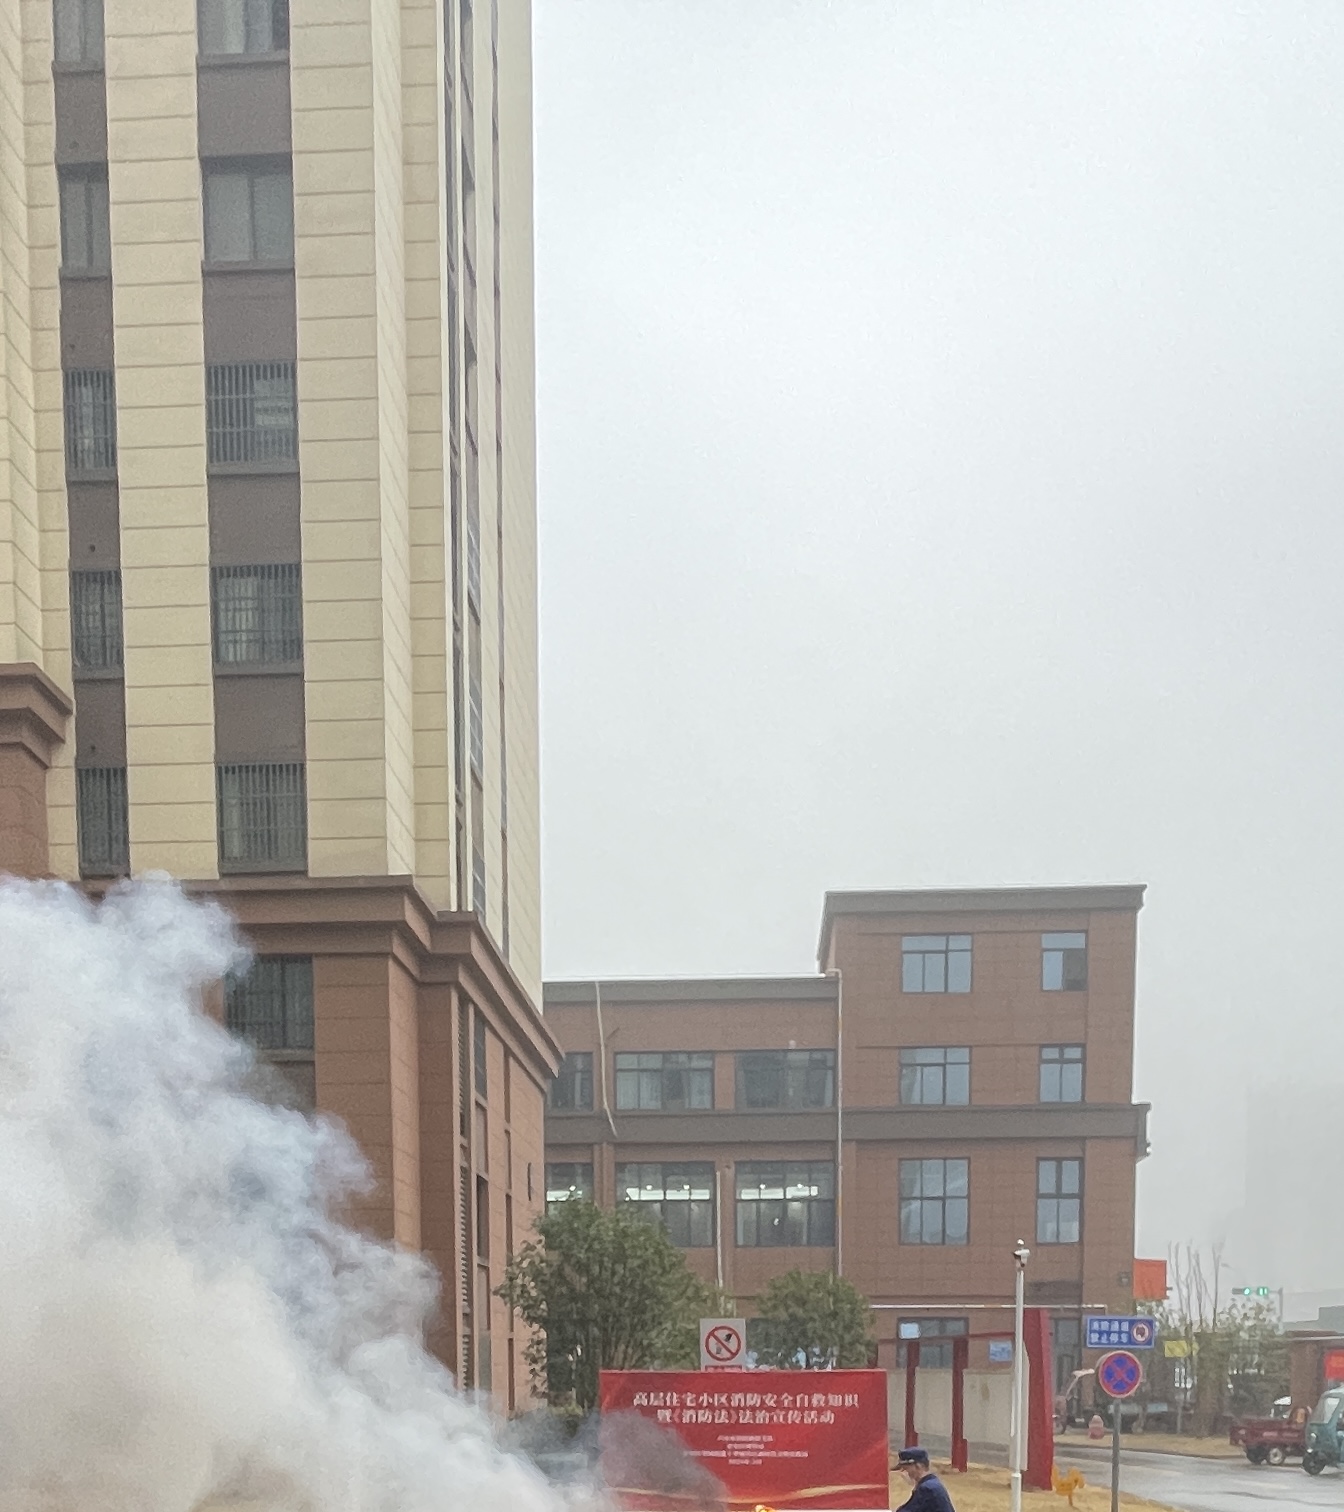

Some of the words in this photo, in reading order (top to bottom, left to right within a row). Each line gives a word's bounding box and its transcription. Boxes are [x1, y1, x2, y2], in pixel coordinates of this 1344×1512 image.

[633, 1392, 859, 1408] 高层住宅小区消防安全自救知识
